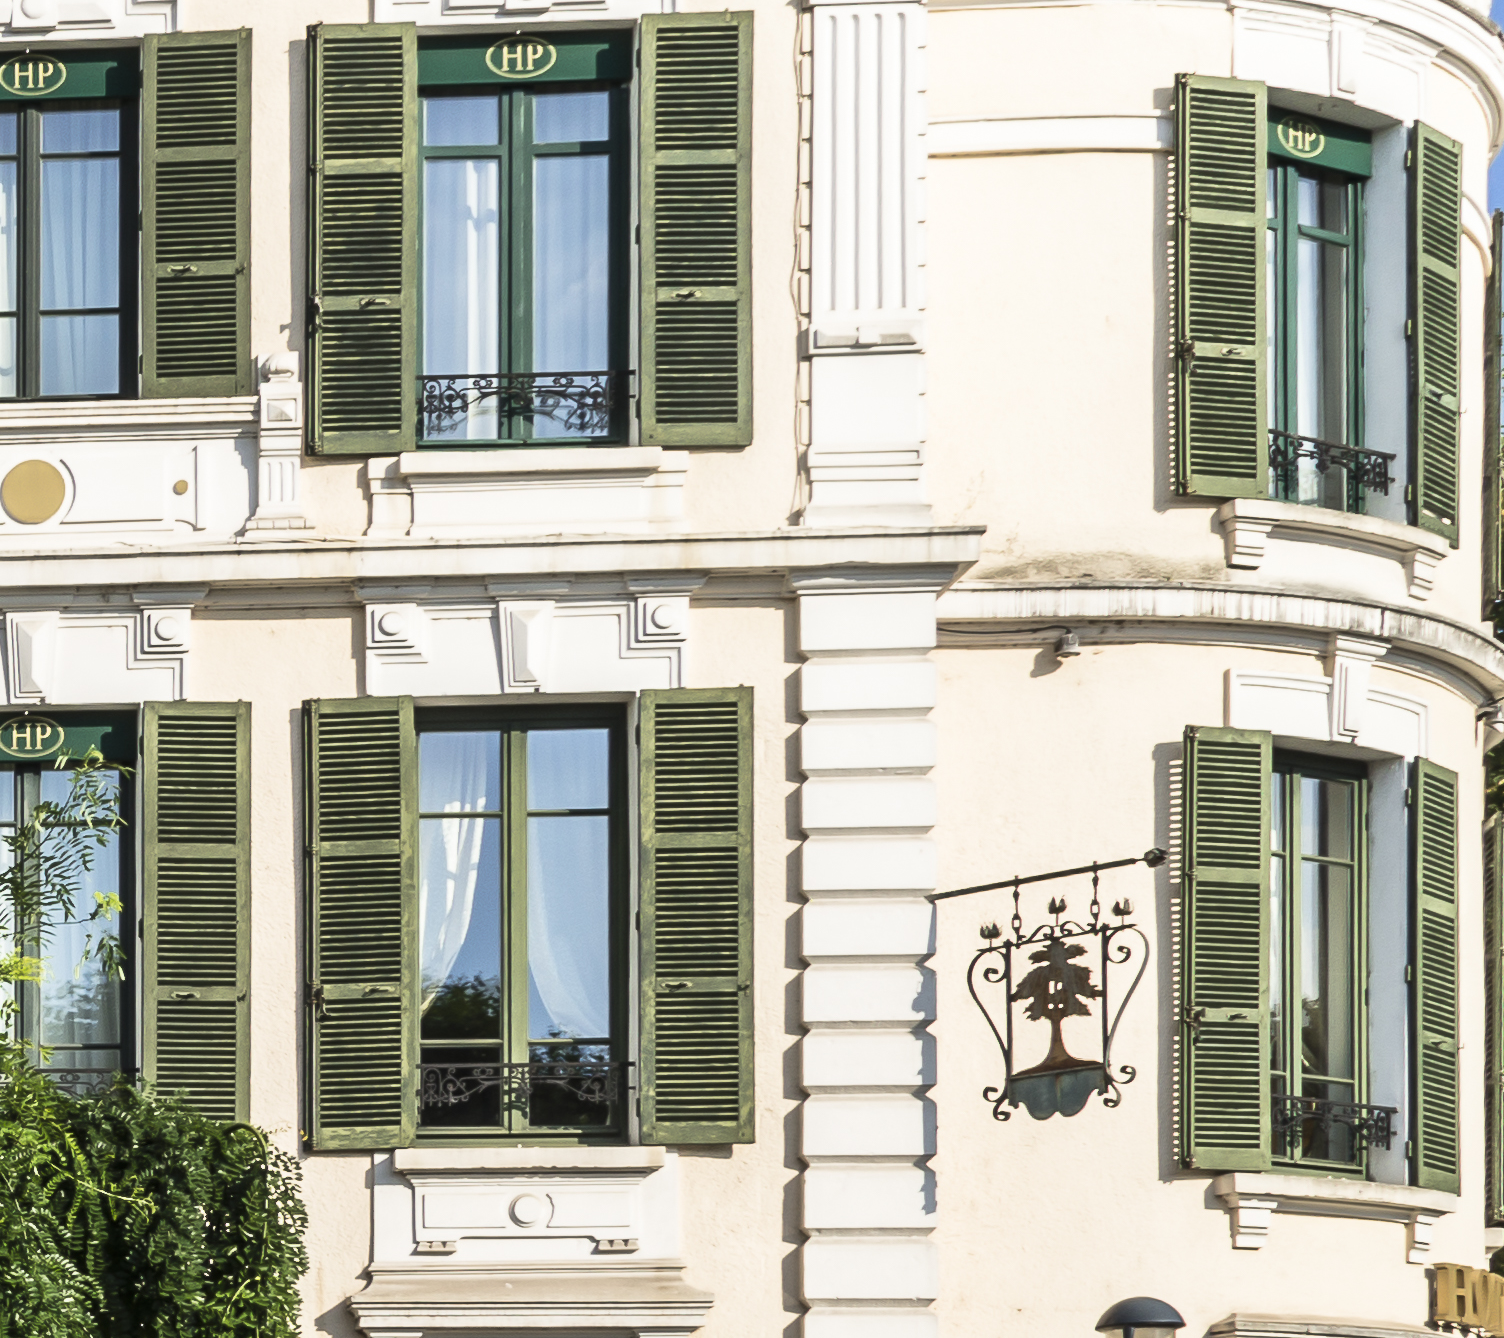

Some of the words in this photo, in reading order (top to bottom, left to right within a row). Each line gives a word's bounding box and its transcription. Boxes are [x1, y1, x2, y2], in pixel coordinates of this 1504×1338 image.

[501, 43, 544, 71] HP
[13, 62, 54, 89] HP
[1288, 120, 1317, 151] HP
[10, 723, 52, 750] HP
